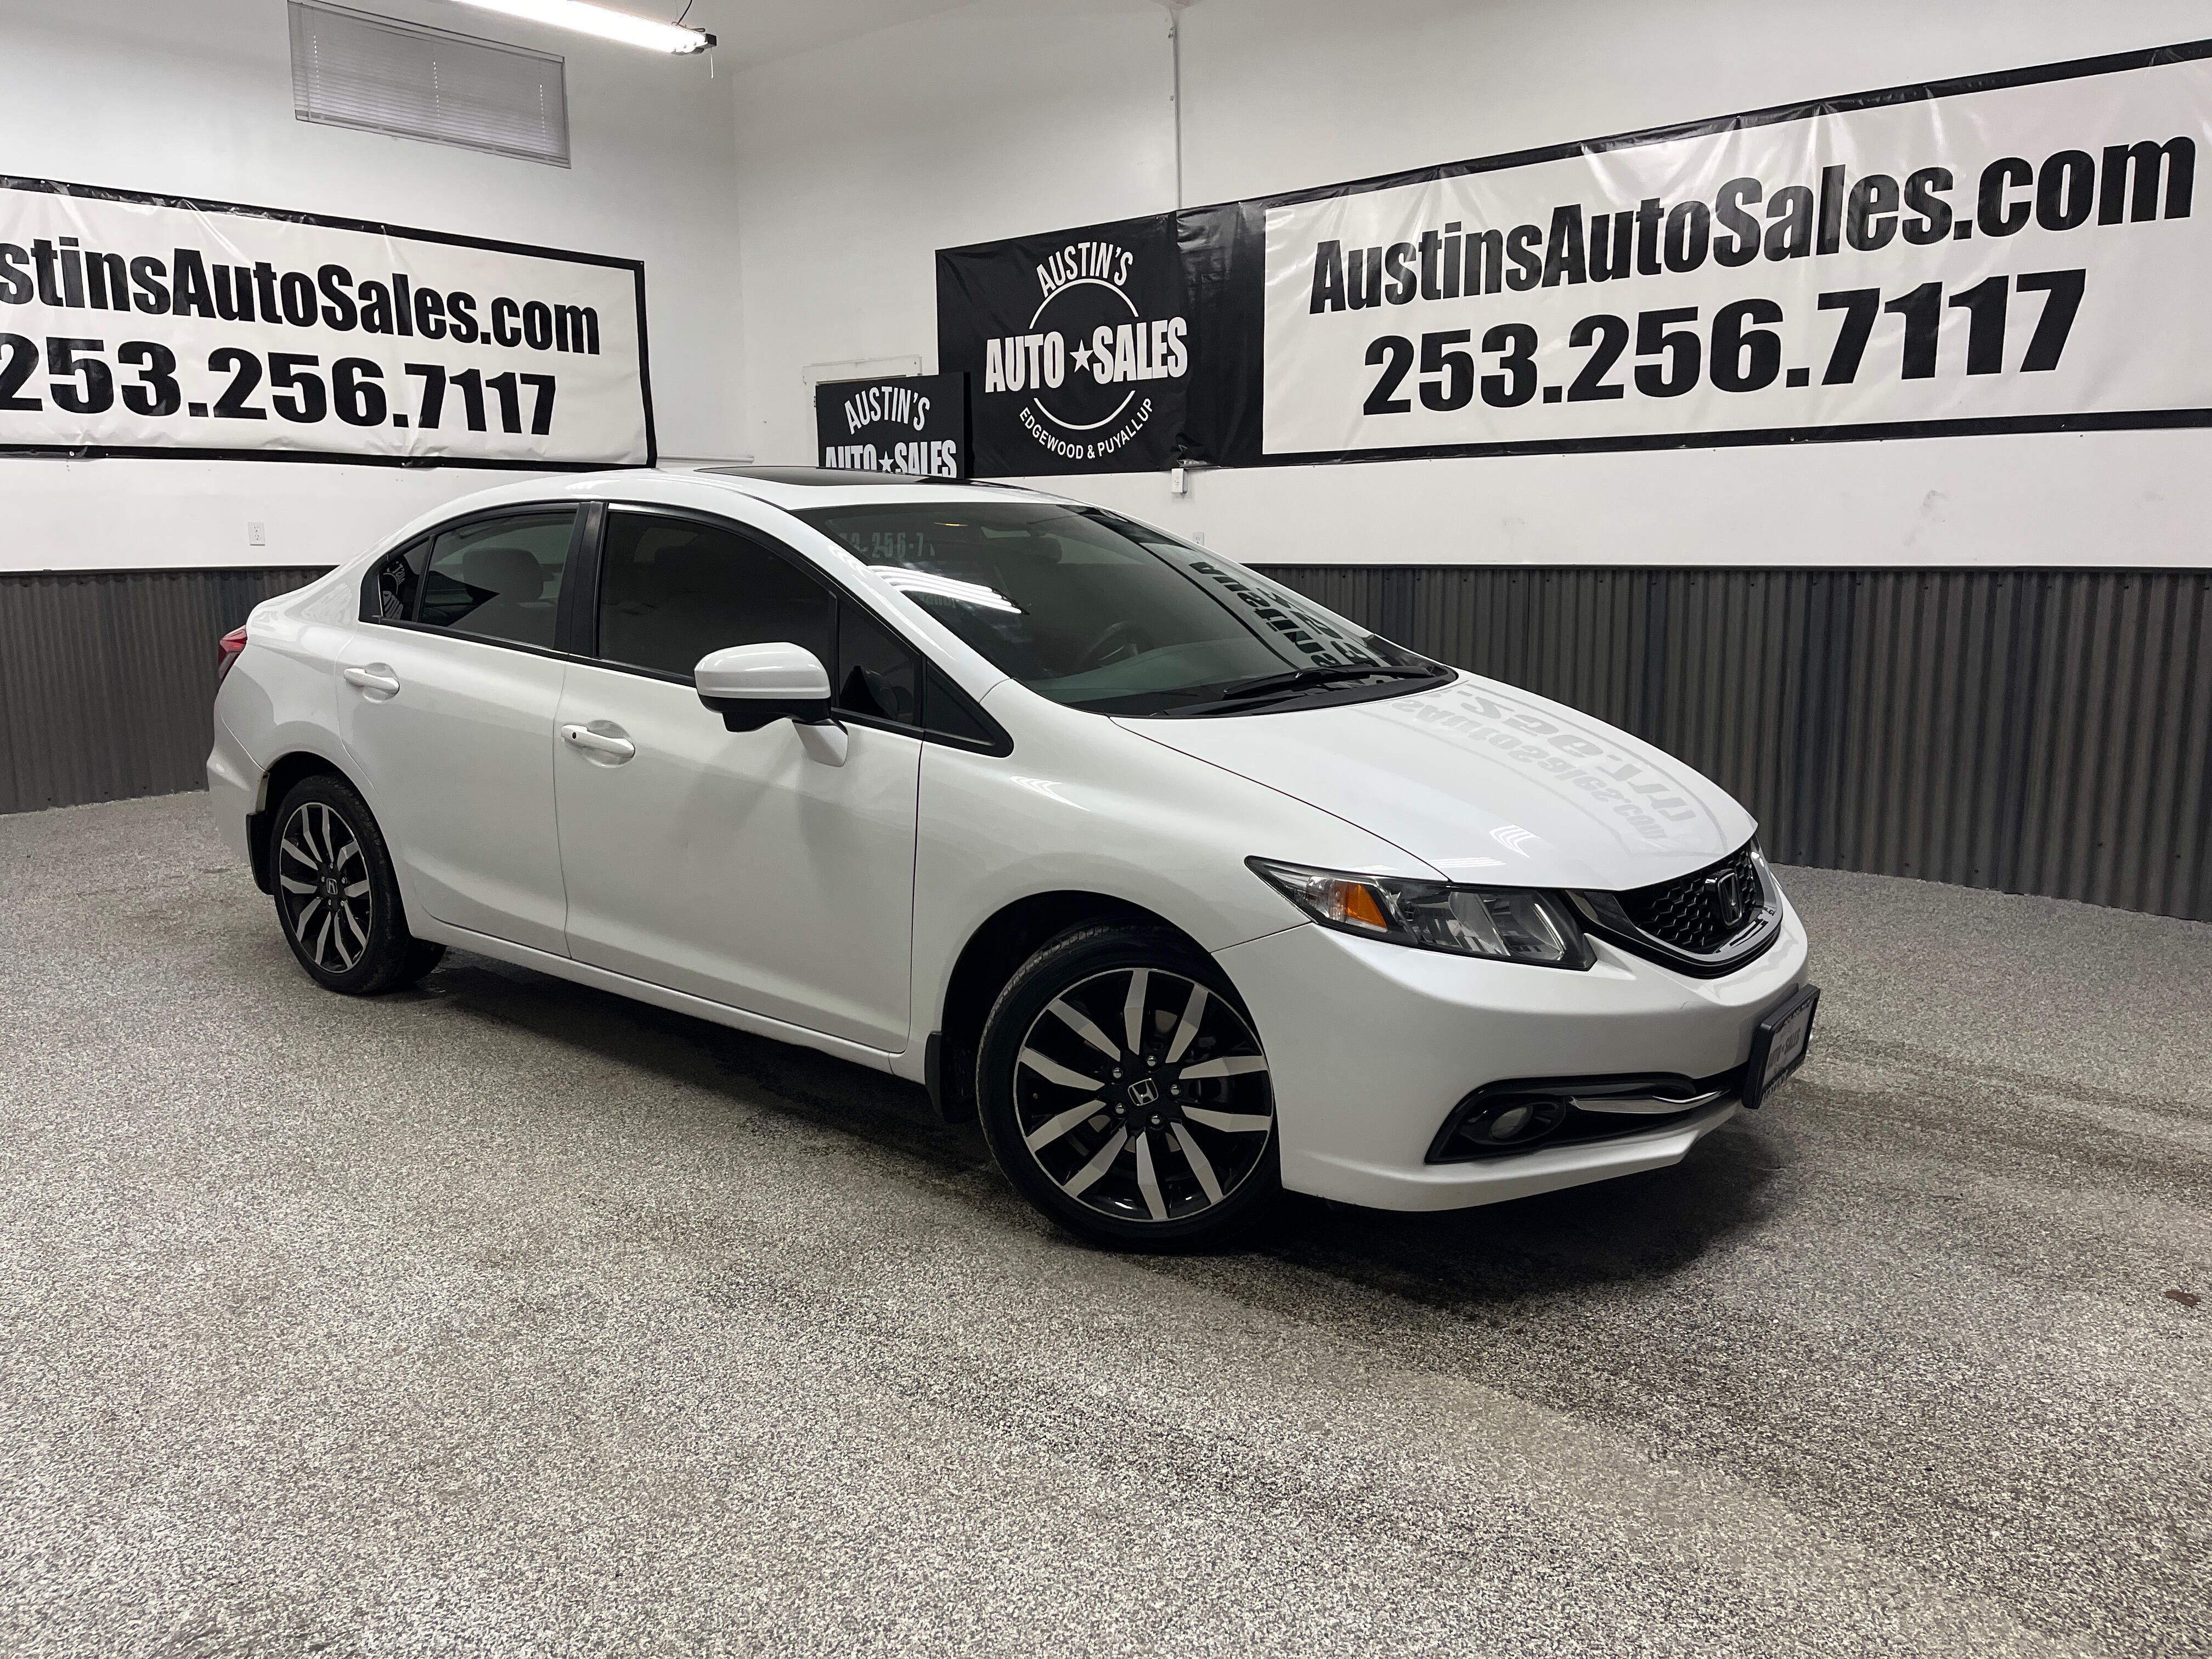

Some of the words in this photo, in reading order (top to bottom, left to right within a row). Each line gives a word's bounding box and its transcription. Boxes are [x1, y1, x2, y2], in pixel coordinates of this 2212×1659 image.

[1310, 136, 2196, 315] AustinsAutoSales.com
[0, 236, 600, 356] stinsAutoSales.com
[1036, 241, 1133, 298] AUSTIN'S
[985, 331, 1065, 393] AUTO
[1092, 317, 1188, 384] SALES
[1363, 268, 2087, 416] 253.256.7117
[0, 332, 556, 436] 253.256.7117
[844, 386, 930, 435] AUSTIN'S
[895, 439, 957, 478] SALES
[1019, 407, 1084, 459] EDGEWOOD
[1087, 444, 1096, 459] &
[1097, 398, 1153, 457] PUYALLUP
